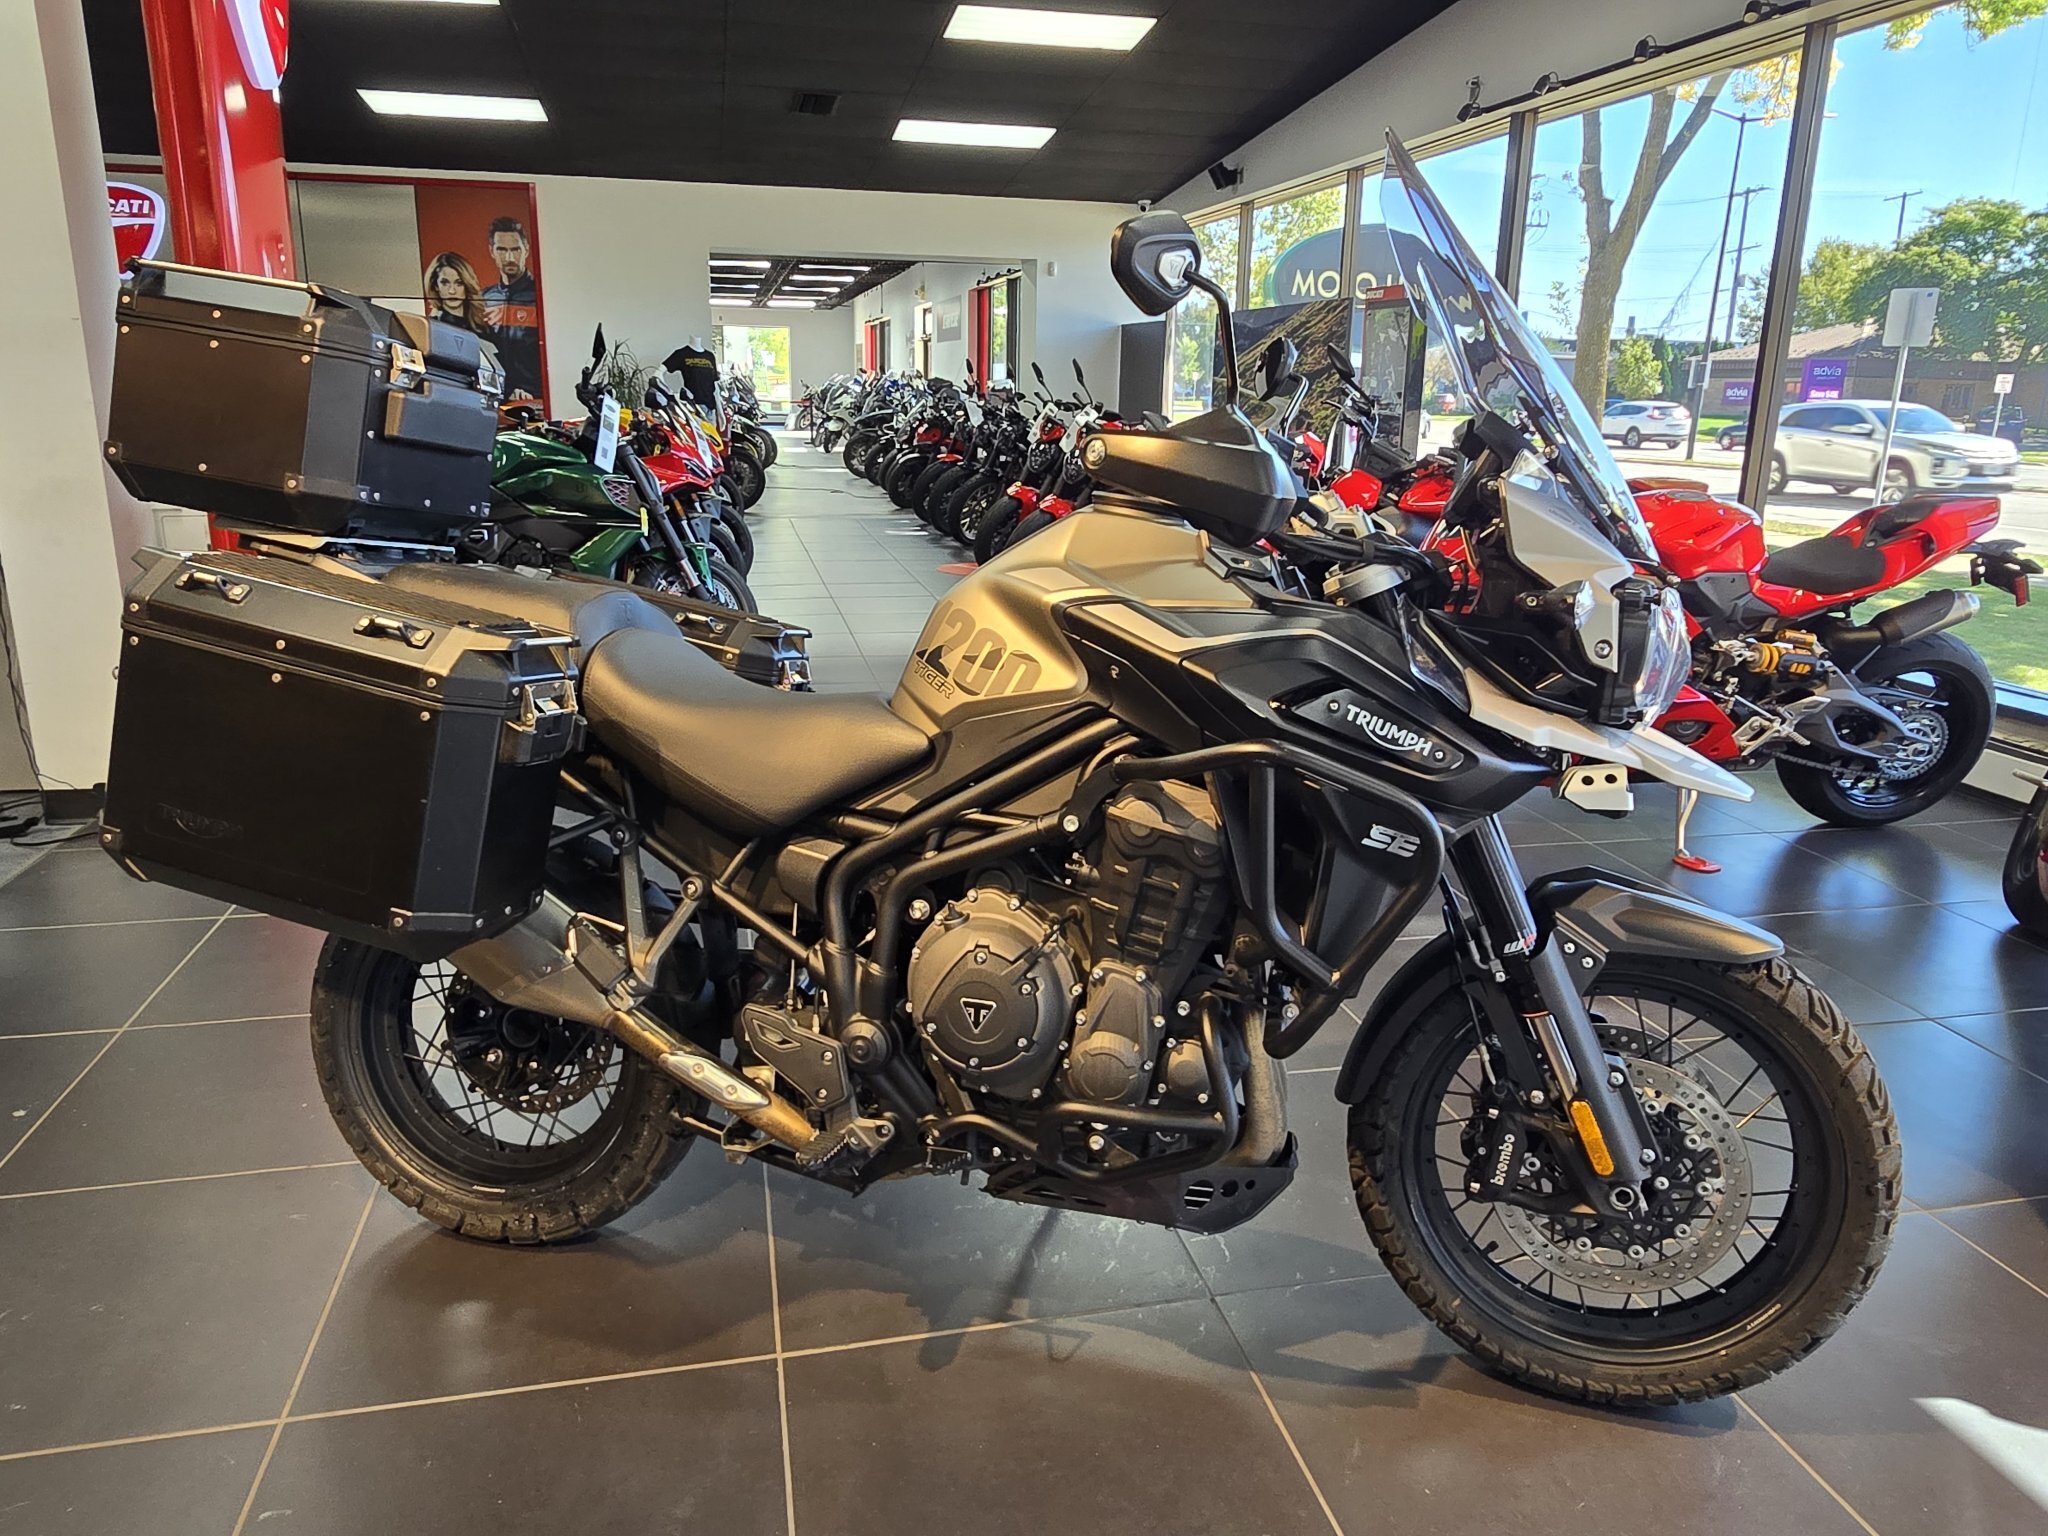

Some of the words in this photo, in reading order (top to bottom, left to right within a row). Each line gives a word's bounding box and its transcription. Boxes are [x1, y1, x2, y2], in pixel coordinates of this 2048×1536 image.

[1291, 269, 1376, 299] MOO
[1813, 366, 1841, 376] advia
[1725, 387, 1748, 397] advia
[914, 660, 955, 699] TIGER
[1347, 703, 1433, 757] TRIUMPH
[1360, 824, 1421, 858] SE
